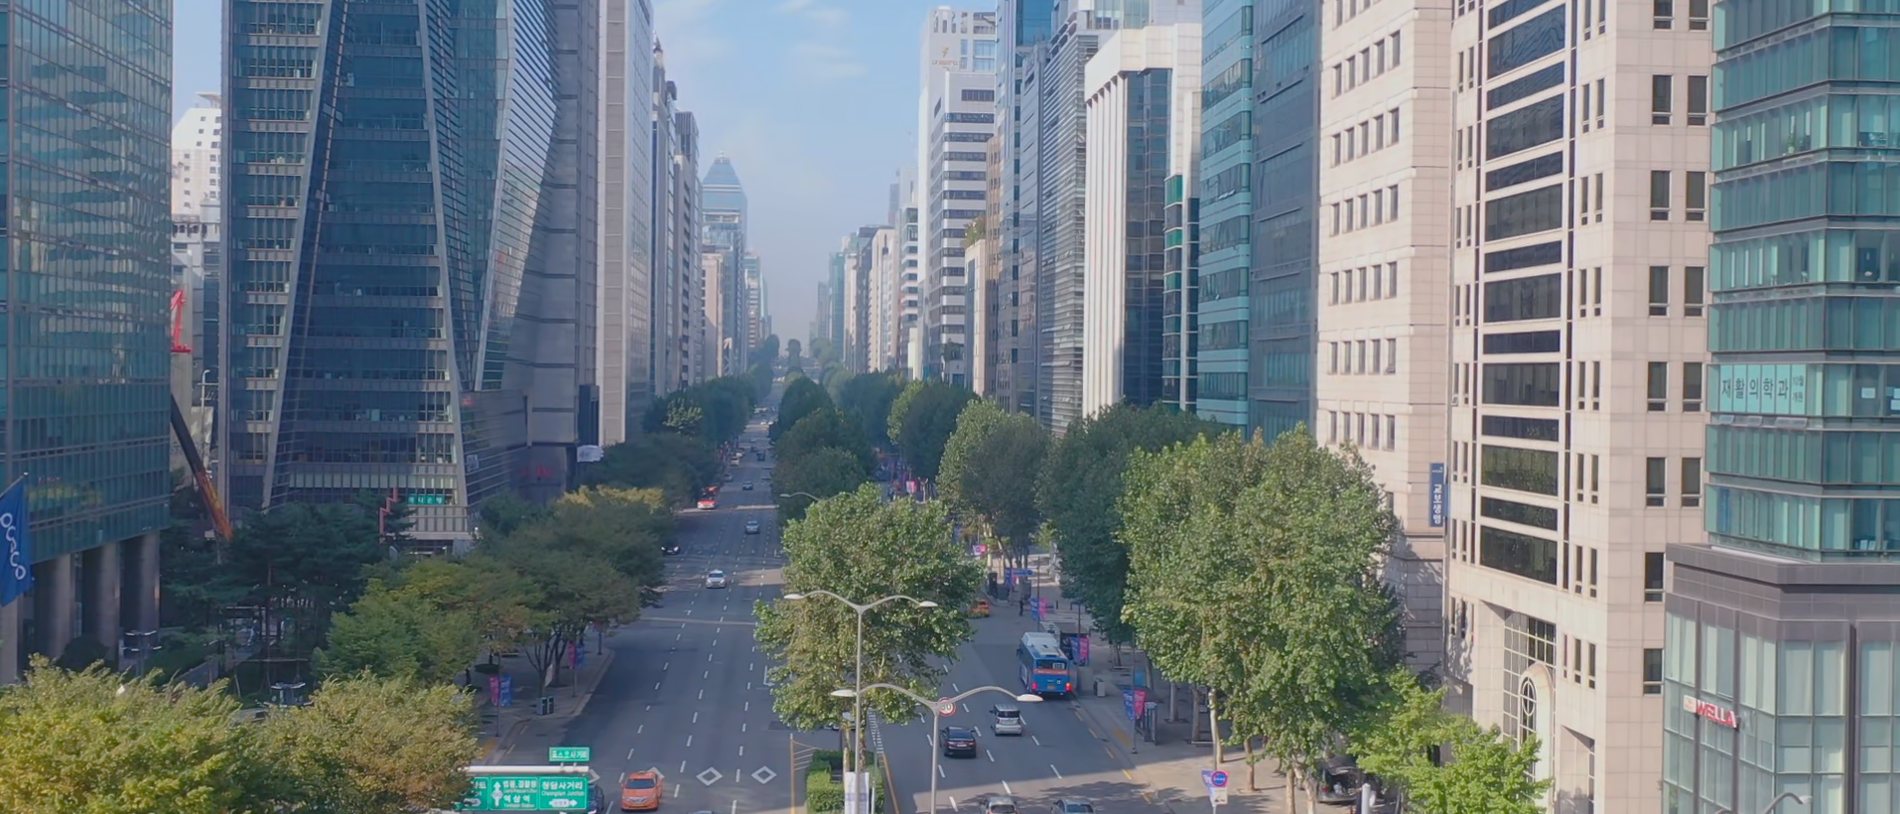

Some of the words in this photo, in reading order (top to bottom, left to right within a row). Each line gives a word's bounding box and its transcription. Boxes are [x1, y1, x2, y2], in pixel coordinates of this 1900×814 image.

[1721, 378, 1789, 400] 재활의학과
[1432, 484, 1443, 525] 교보생명
[1696, 700, 1737, 728] WELLA
